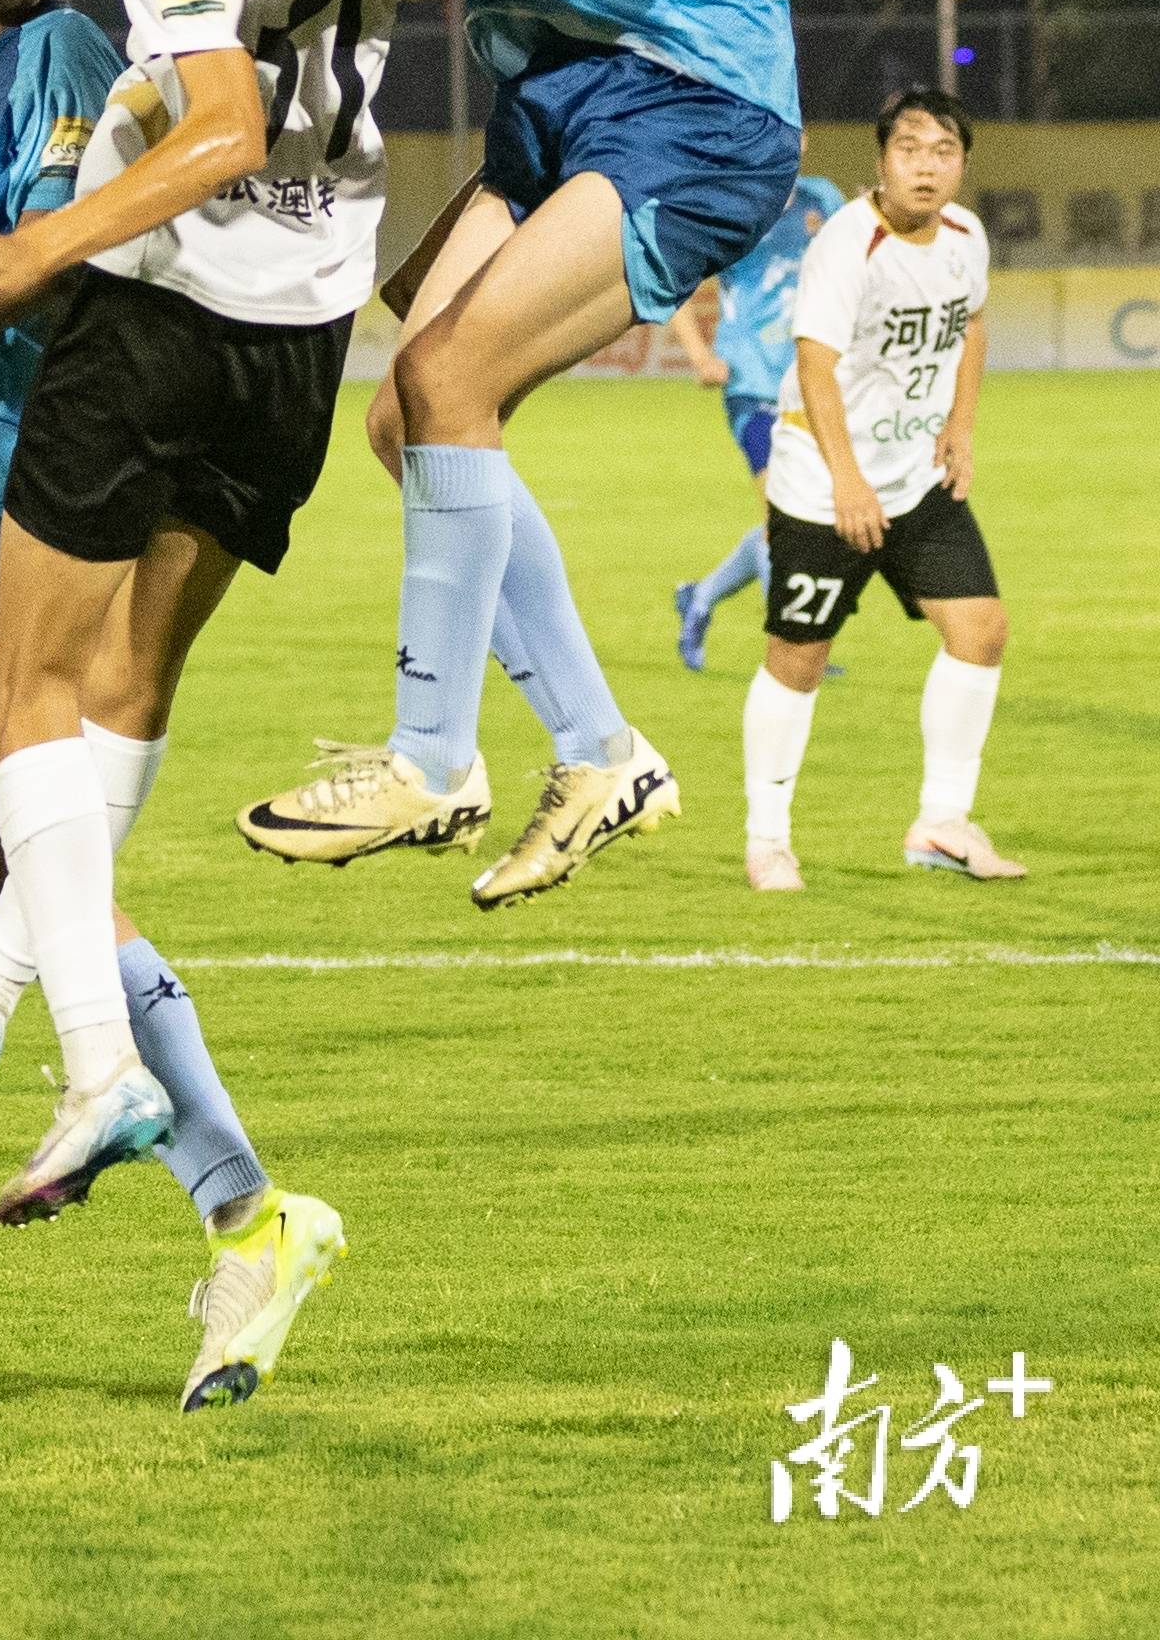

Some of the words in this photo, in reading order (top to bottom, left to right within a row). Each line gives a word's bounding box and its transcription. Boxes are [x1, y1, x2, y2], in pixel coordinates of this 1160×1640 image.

[879, 295, 969, 357] 河源
[905, 363, 939, 400] 27
[780, 572, 845, 626] 27
